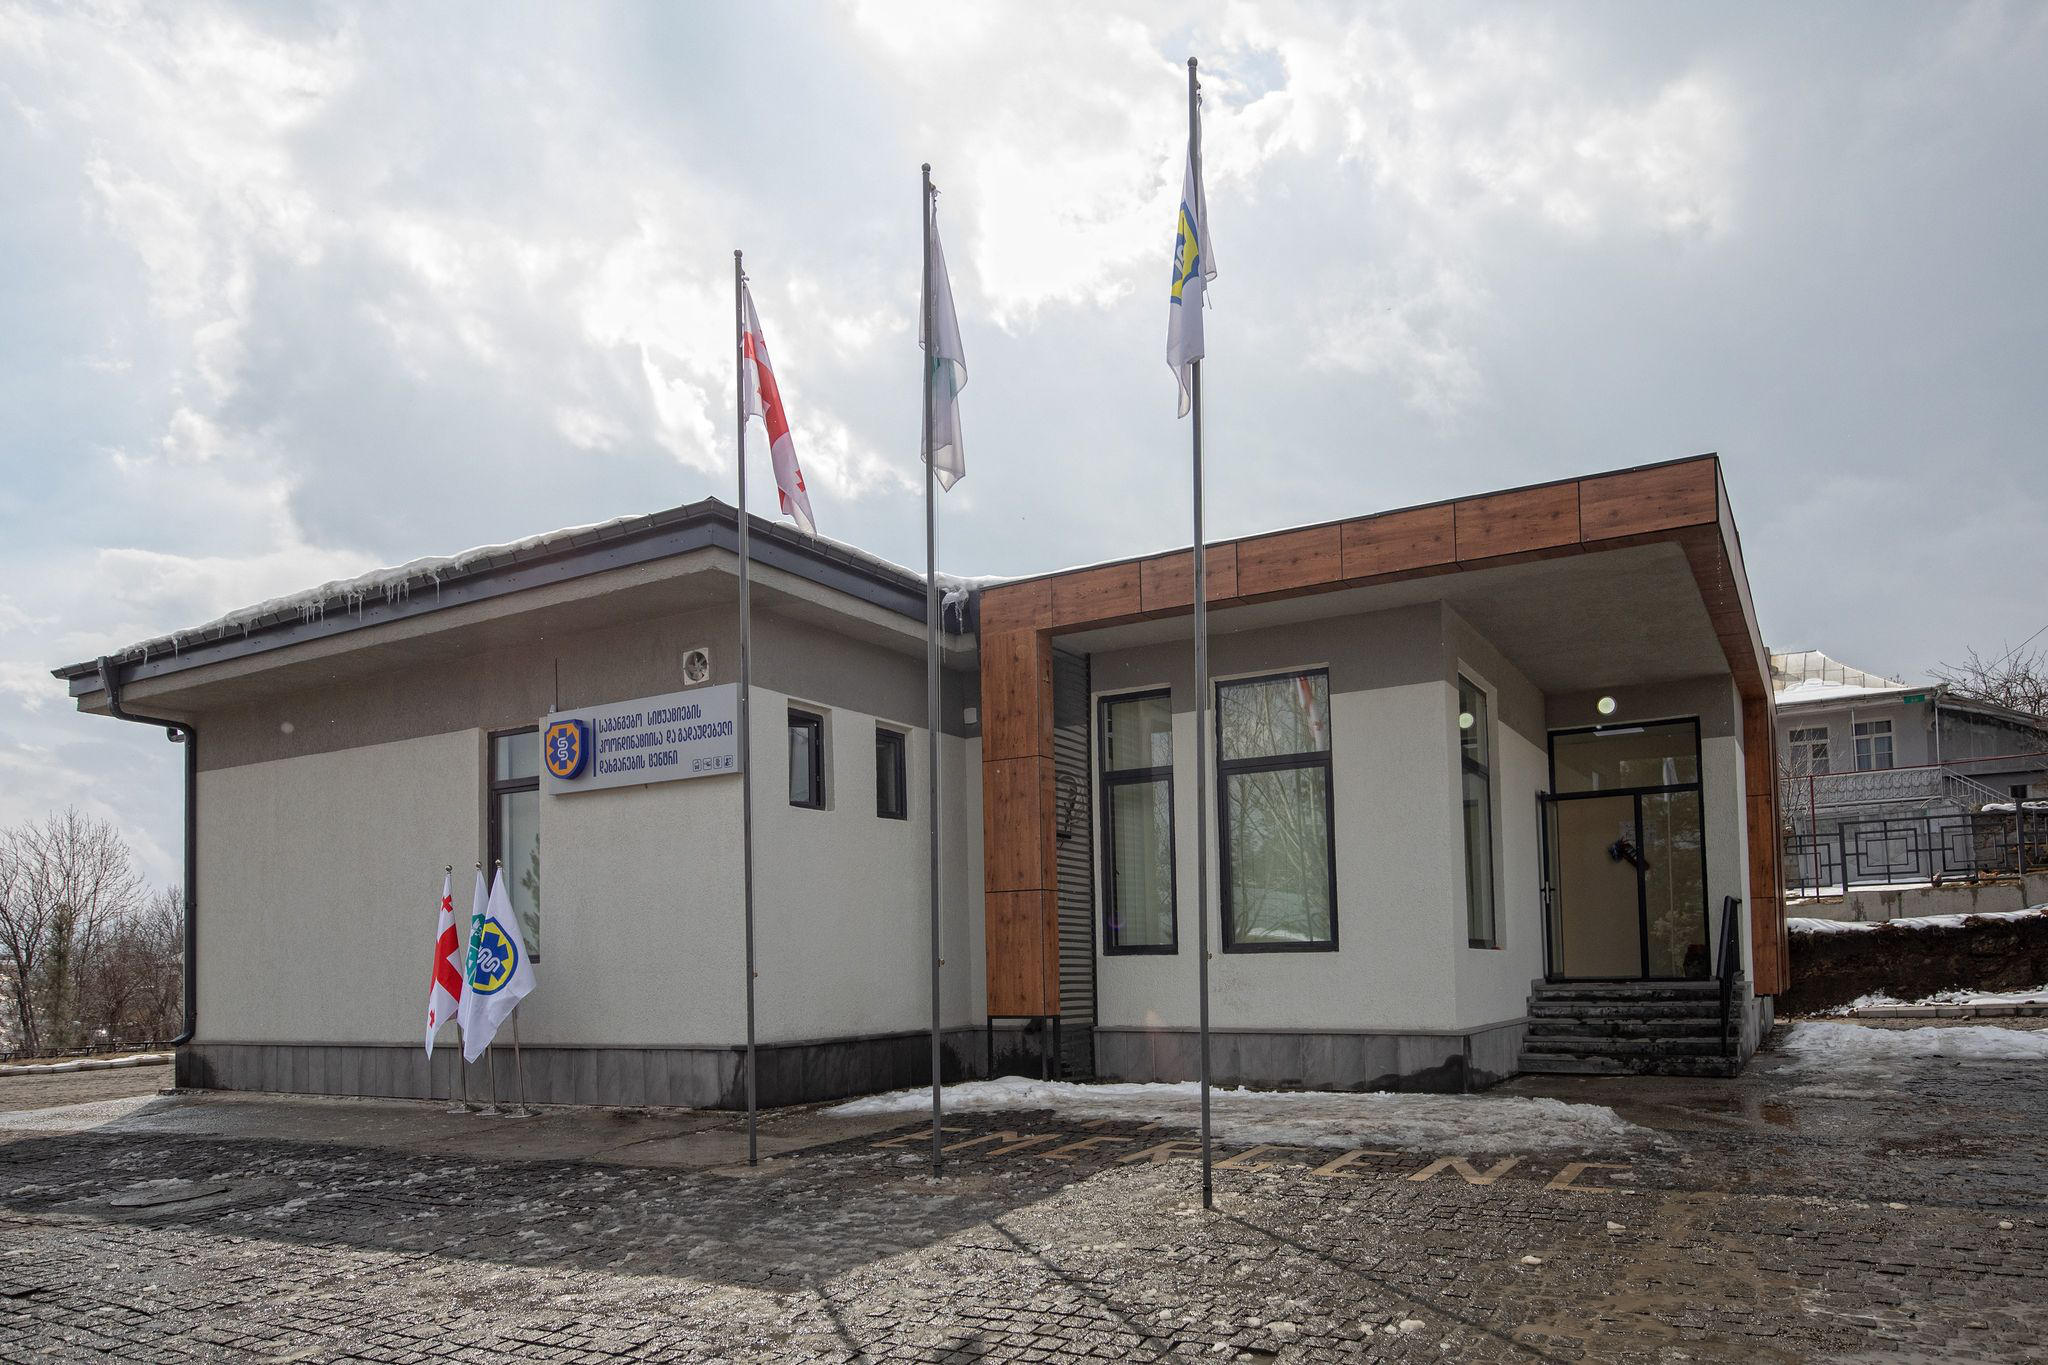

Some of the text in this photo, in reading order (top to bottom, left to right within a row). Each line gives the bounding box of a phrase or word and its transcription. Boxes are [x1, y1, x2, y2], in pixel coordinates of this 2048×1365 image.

[599, 704, 702, 733] საგანგებო სიტუაციების
[666, 729, 677, 744] და
[599, 750, 678, 774] დახმარების ცენტრი
